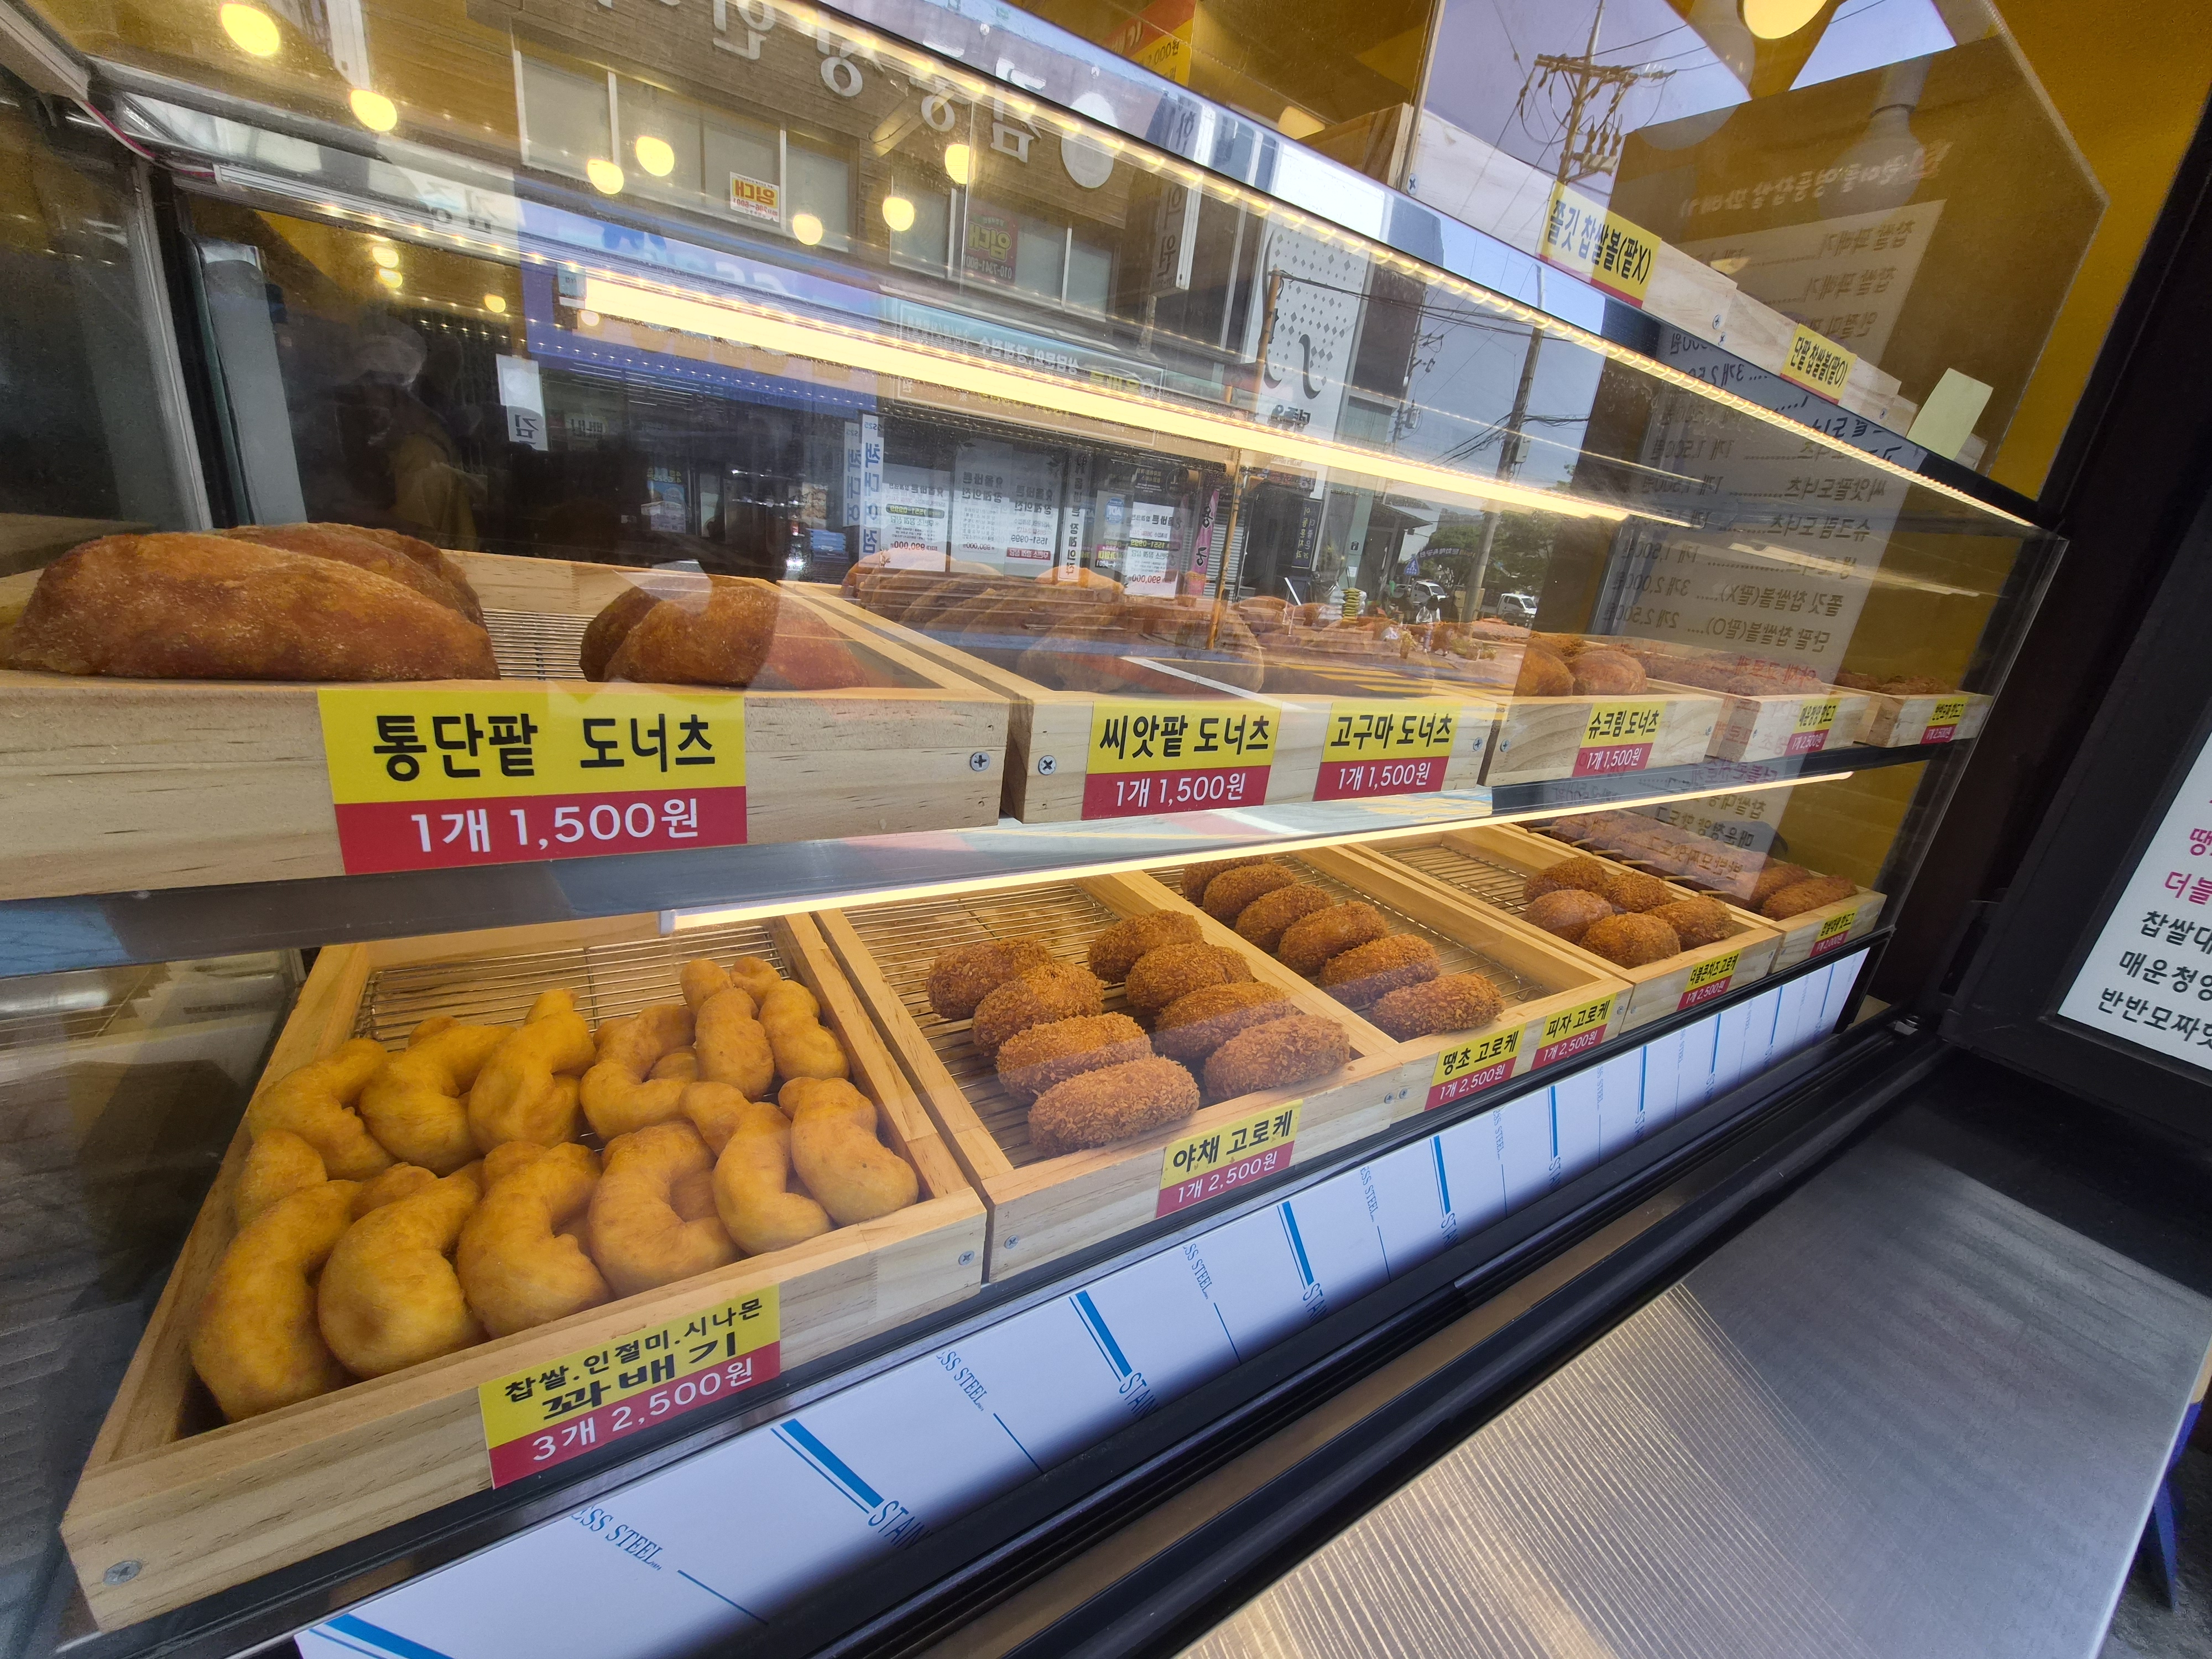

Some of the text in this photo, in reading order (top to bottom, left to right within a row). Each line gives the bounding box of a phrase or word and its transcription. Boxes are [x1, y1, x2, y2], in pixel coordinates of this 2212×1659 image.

[1547, 200, 1652, 285] 쫄깃 찹쌀볼(팥X)
[1099, 714, 1269, 759] 씨앗팥 도너츠
[1330, 712, 1452, 750] 고구마 도너츠
[1588, 709, 1660, 740] 슈크림 도너츠
[373, 713, 715, 781] 통단팥 도너츠
[1586, 747, 1642, 771] 1개 1,500원
[1115, 772, 1246, 807] 1개 1,500원
[1338, 761, 1431, 790] 1개 1,500원
[410, 797, 698, 853] 1개 1,500원
[2189, 828, 2212, 856] 땡
[1690, 953, 1739, 986] 더블콘치즈 고로케
[1697, 980, 1724, 1000] 2,500원
[1546, 999, 1611, 1039] 피자 고로케
[1443, 1031, 1520, 1076] 땡초 고로케
[1543, 1030, 1598, 1062] 1개 2,500원
[1439, 1063, 1506, 1100] 1개 2,500원
[1172, 1109, 1293, 1173] 야채 고로케
[1177, 1150, 1278, 1203] 1개 2,500원
[1364, 1185, 1380, 1214] STEEL
[1192, 1259, 1213, 1293] STEEL
[542, 1332, 737, 1420] 꽈배기
[954, 1368, 988, 1403] STEEL
[532, 1358, 753, 1462] 3개 2,500원
[605, 1525, 664, 1566] STEEL
